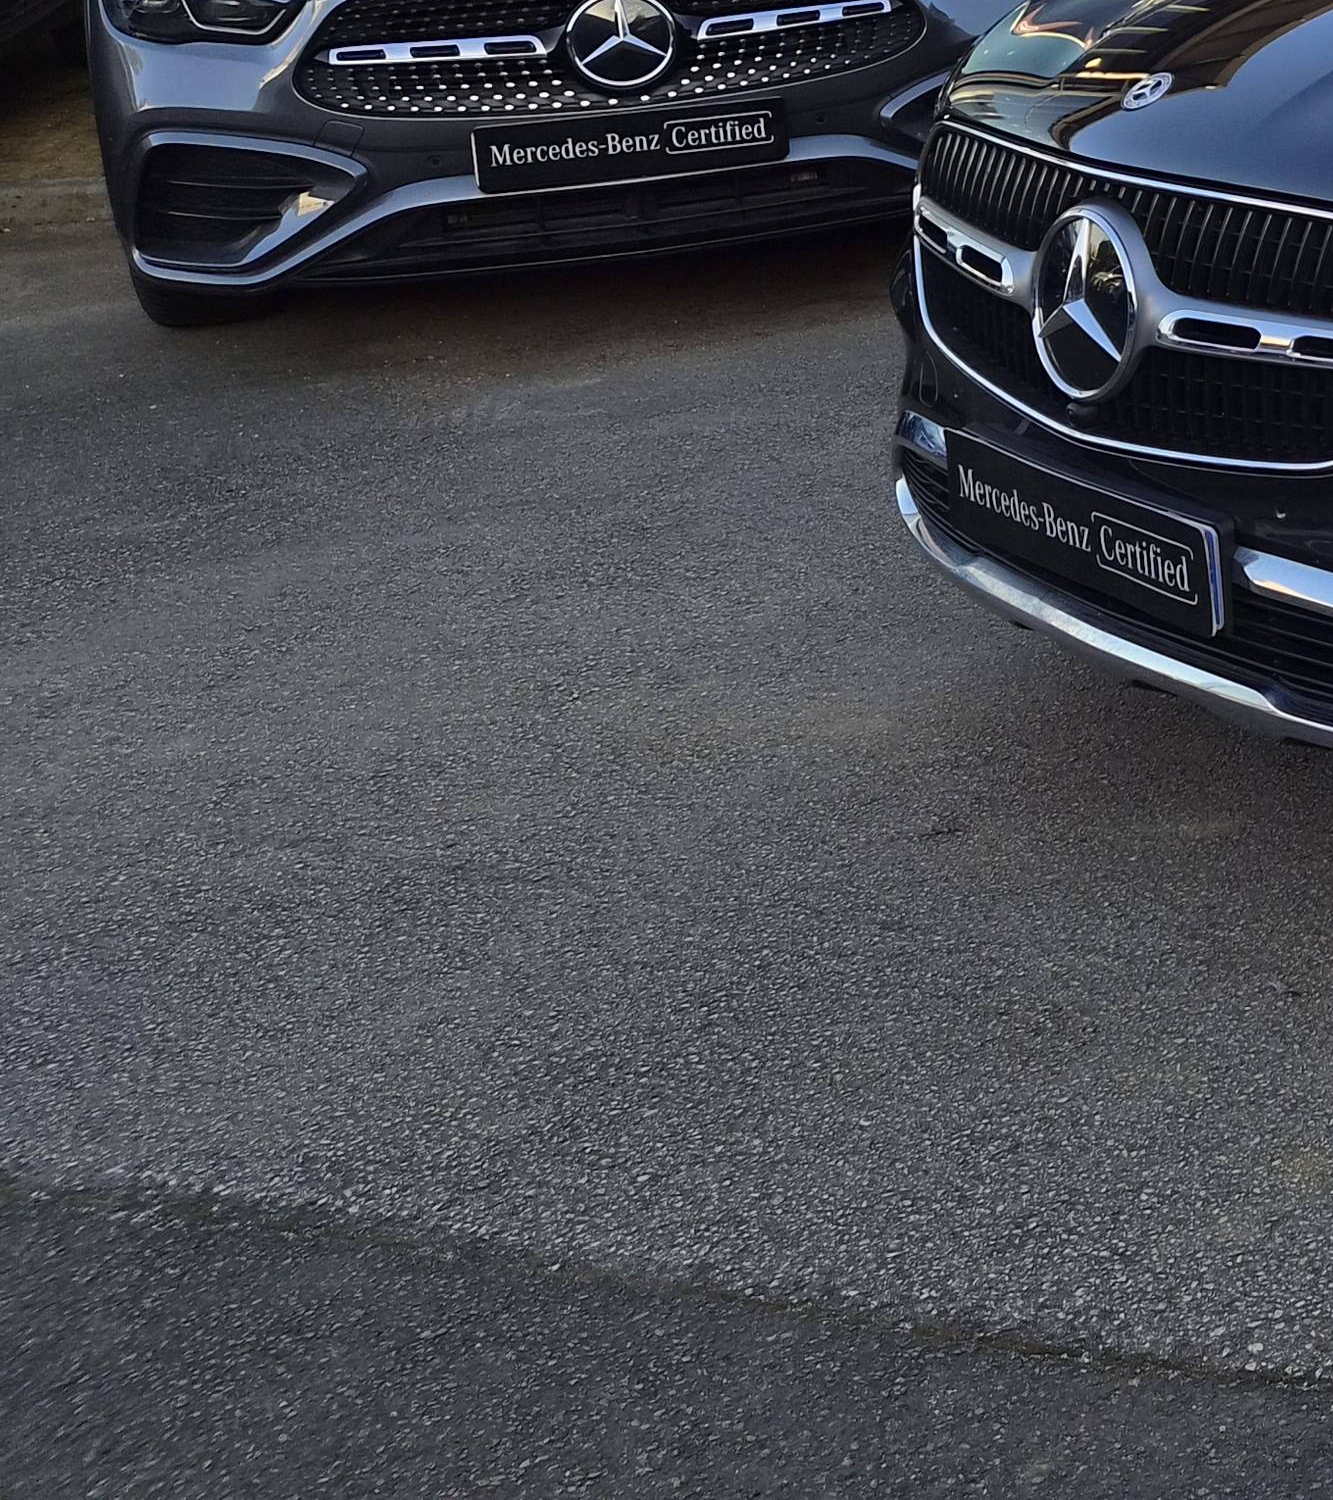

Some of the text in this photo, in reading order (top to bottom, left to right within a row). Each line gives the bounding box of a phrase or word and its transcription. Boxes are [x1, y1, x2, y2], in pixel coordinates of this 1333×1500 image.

[489, 117, 767, 168] Mercedes-Benz Certified
[957, 464, 1190, 592] Mercedes-Benz Certified
